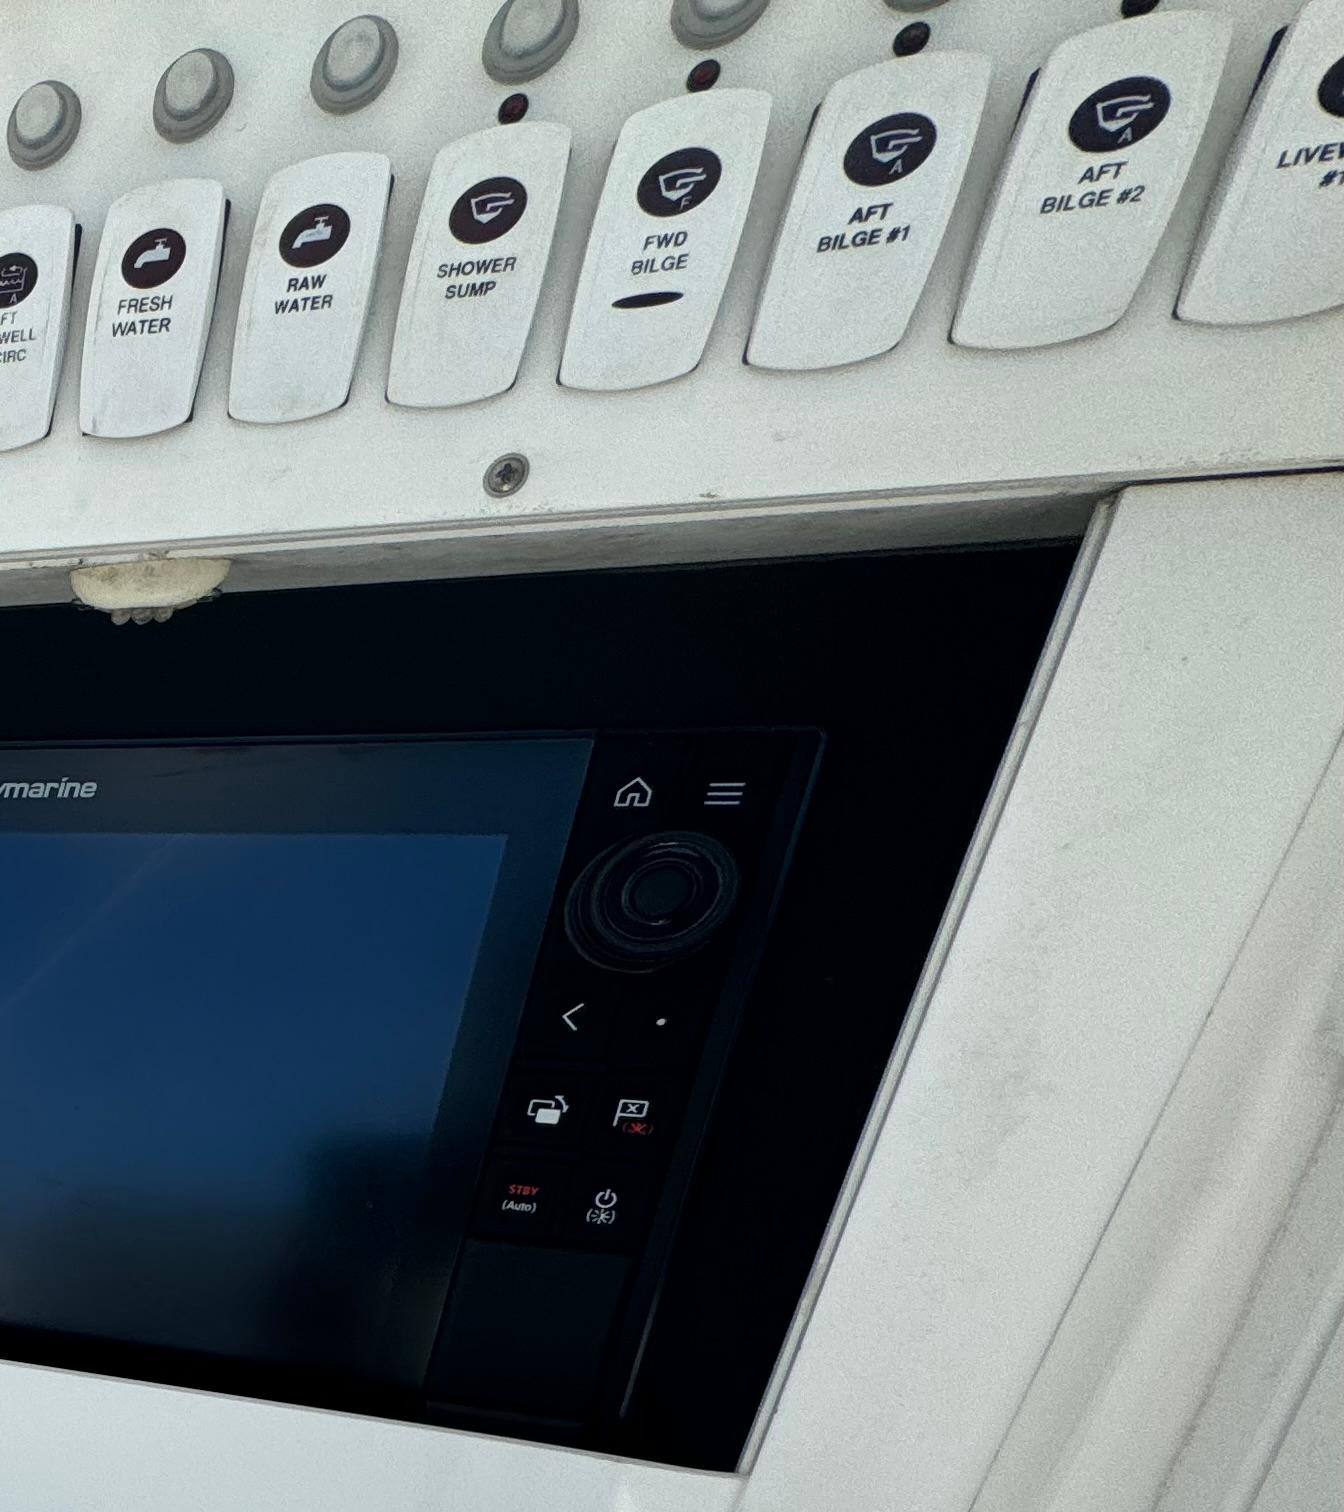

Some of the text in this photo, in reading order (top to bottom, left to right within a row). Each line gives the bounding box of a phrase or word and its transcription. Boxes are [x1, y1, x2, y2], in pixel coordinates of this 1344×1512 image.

[1276, 141, 1344, 169] LIVE
[1078, 160, 1128, 183] AFT
[1040, 184, 1145, 215] BILGE #2
[847, 201, 893, 227] AFT
[642, 229, 689, 252] FWD
[816, 223, 910, 253] BILGE #1
[436, 255, 518, 279] SHOWER
[630, 252, 689, 277] BILGE
[286, 273, 328, 293] RAW
[444, 280, 497, 300] SUMP
[117, 294, 174, 316] FRESH
[273, 293, 334, 315] WATER
[111, 317, 172, 338] WATER
[508, 1184, 540, 1196] STBY
